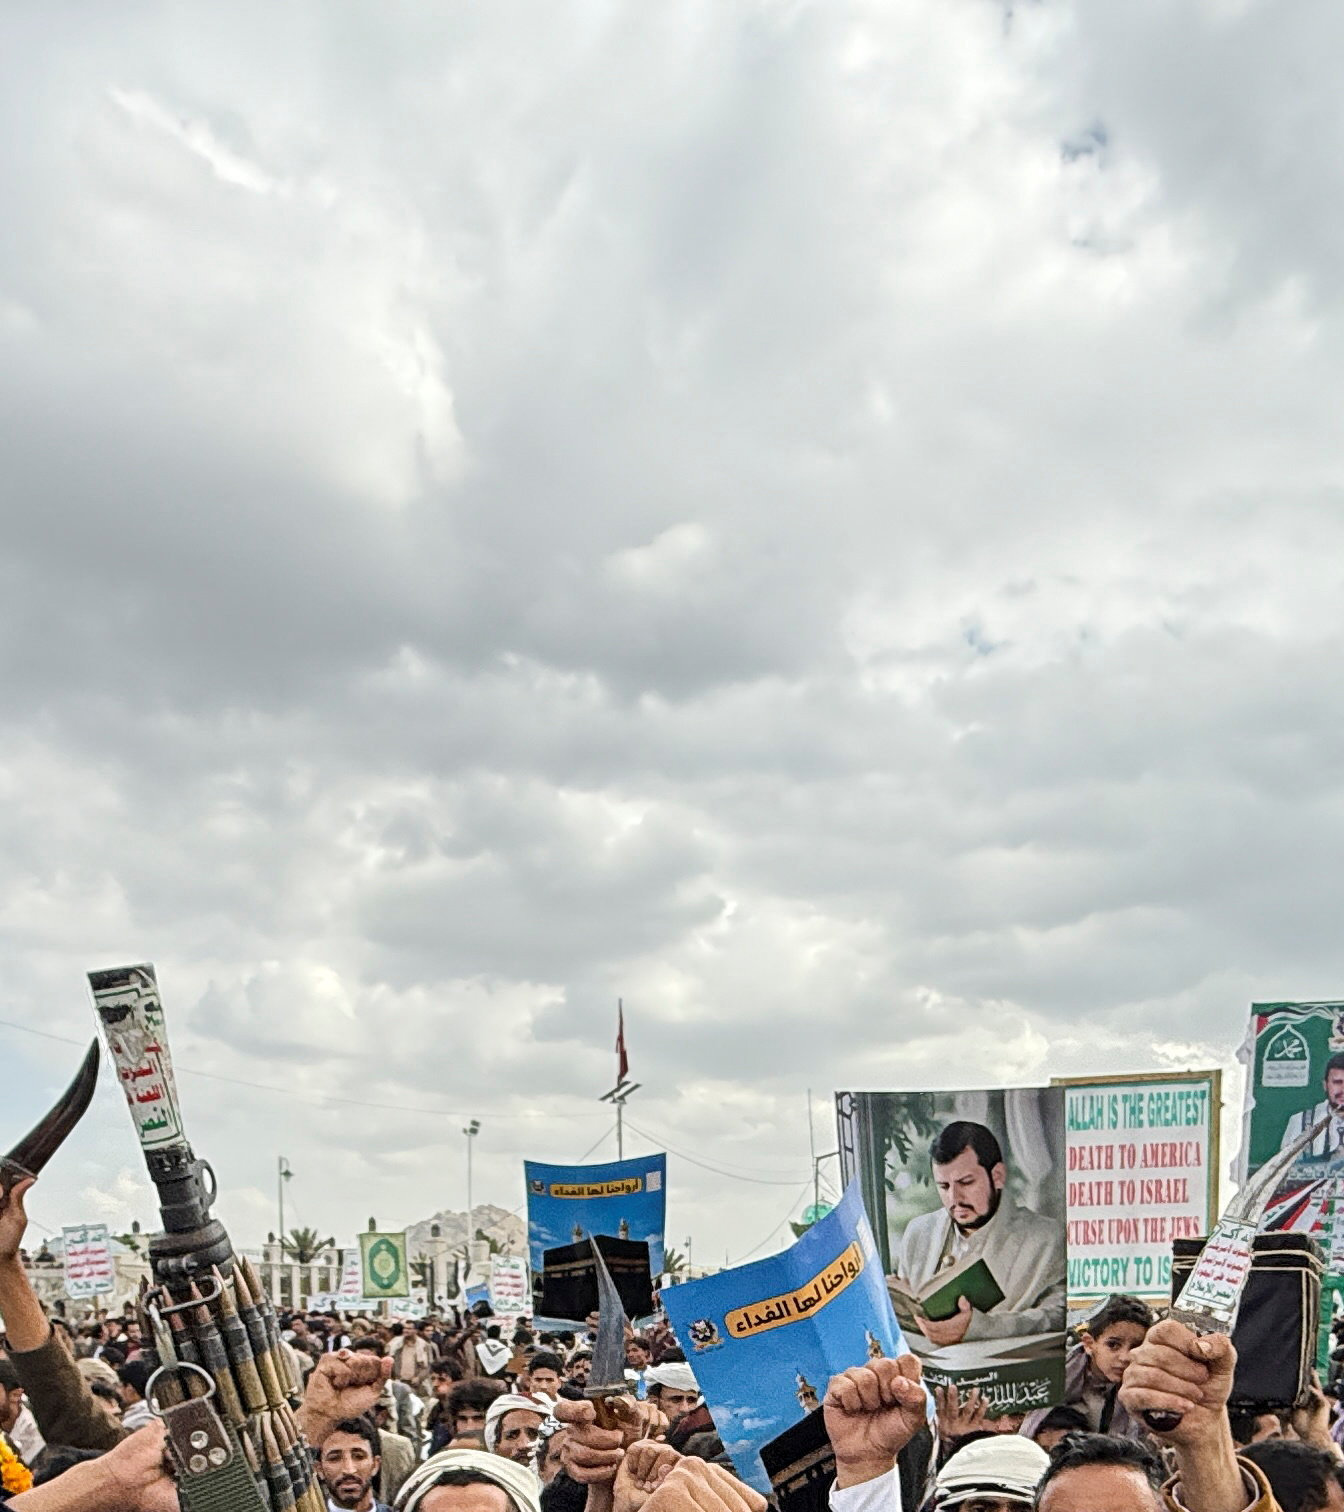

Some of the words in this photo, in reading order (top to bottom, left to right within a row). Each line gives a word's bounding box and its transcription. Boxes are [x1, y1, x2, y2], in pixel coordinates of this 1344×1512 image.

[1067, 1095, 1104, 1132] ALLAH
[1107, 1095, 1118, 1130] IS
[1121, 1093, 1144, 1129] THE
[1147, 1089, 1206, 1128] GREATEST
[1069, 1144, 1114, 1171] DEATH
[1118, 1143, 1136, 1170] TO
[1140, 1141, 1202, 1169] AMERICA
[1069, 1180, 1114, 1207] DEATH
[1118, 1179, 1135, 1206] TO
[1139, 1178, 1189, 1205] ISRAEL
[1067, 1219, 1105, 1246] CURSE
[1108, 1218, 1139, 1245] UPON
[1143, 1217, 1166, 1243] THE
[1168, 1215, 1200, 1241] JEWS
[1067, 1257, 1130, 1288] VICTORY
[1134, 1256, 1153, 1286] TO
[793, 1284, 823, 1314] لها
[736, 1300, 791, 1333] الفداء
[957, 1371, 998, 1387] السيد
